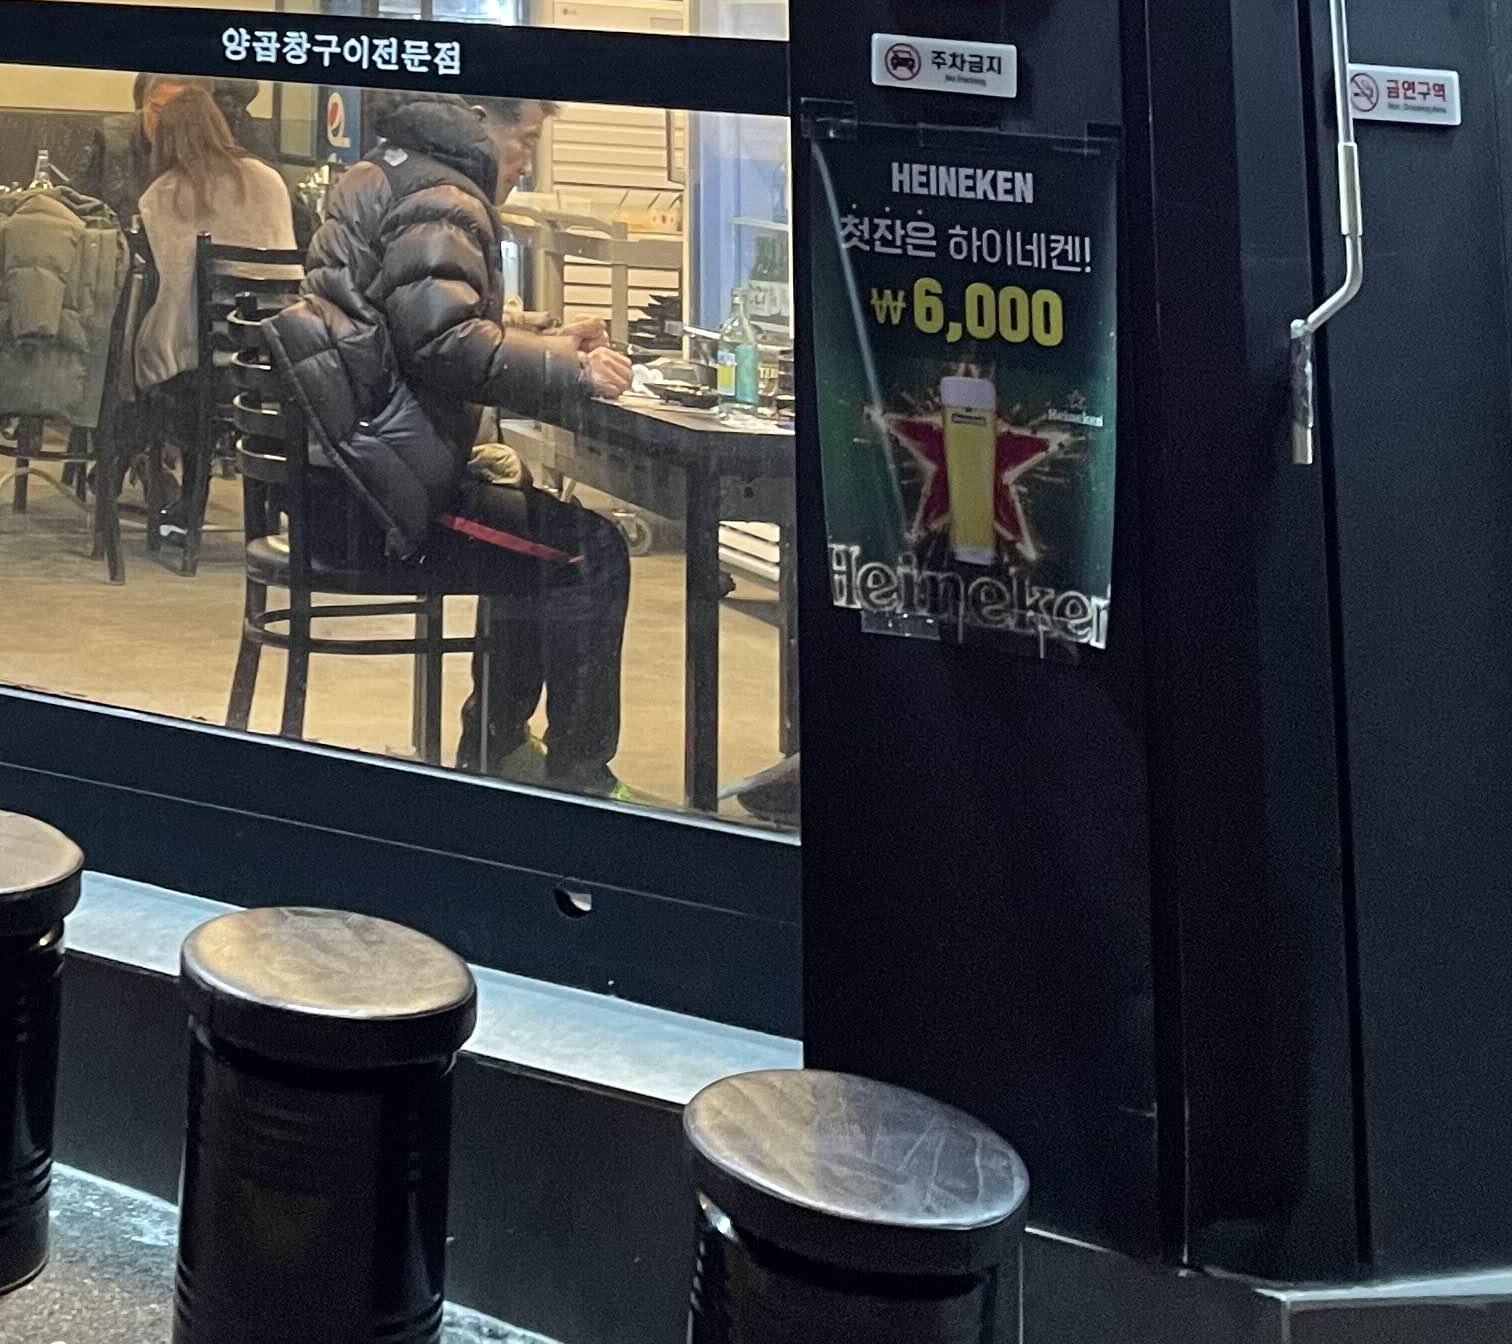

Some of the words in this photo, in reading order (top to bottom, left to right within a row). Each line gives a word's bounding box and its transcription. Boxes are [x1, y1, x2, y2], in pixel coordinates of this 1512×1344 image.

[220, 27, 463, 76] 양곱창구이전문점
[930, 49, 1003, 76] 주차금지
[1385, 78, 1447, 103] 금연구역
[891, 161, 1034, 204] HEINEKEN
[839, 214, 938, 259] 첫잔은
[947, 223, 1092, 274] 하이네켄!
